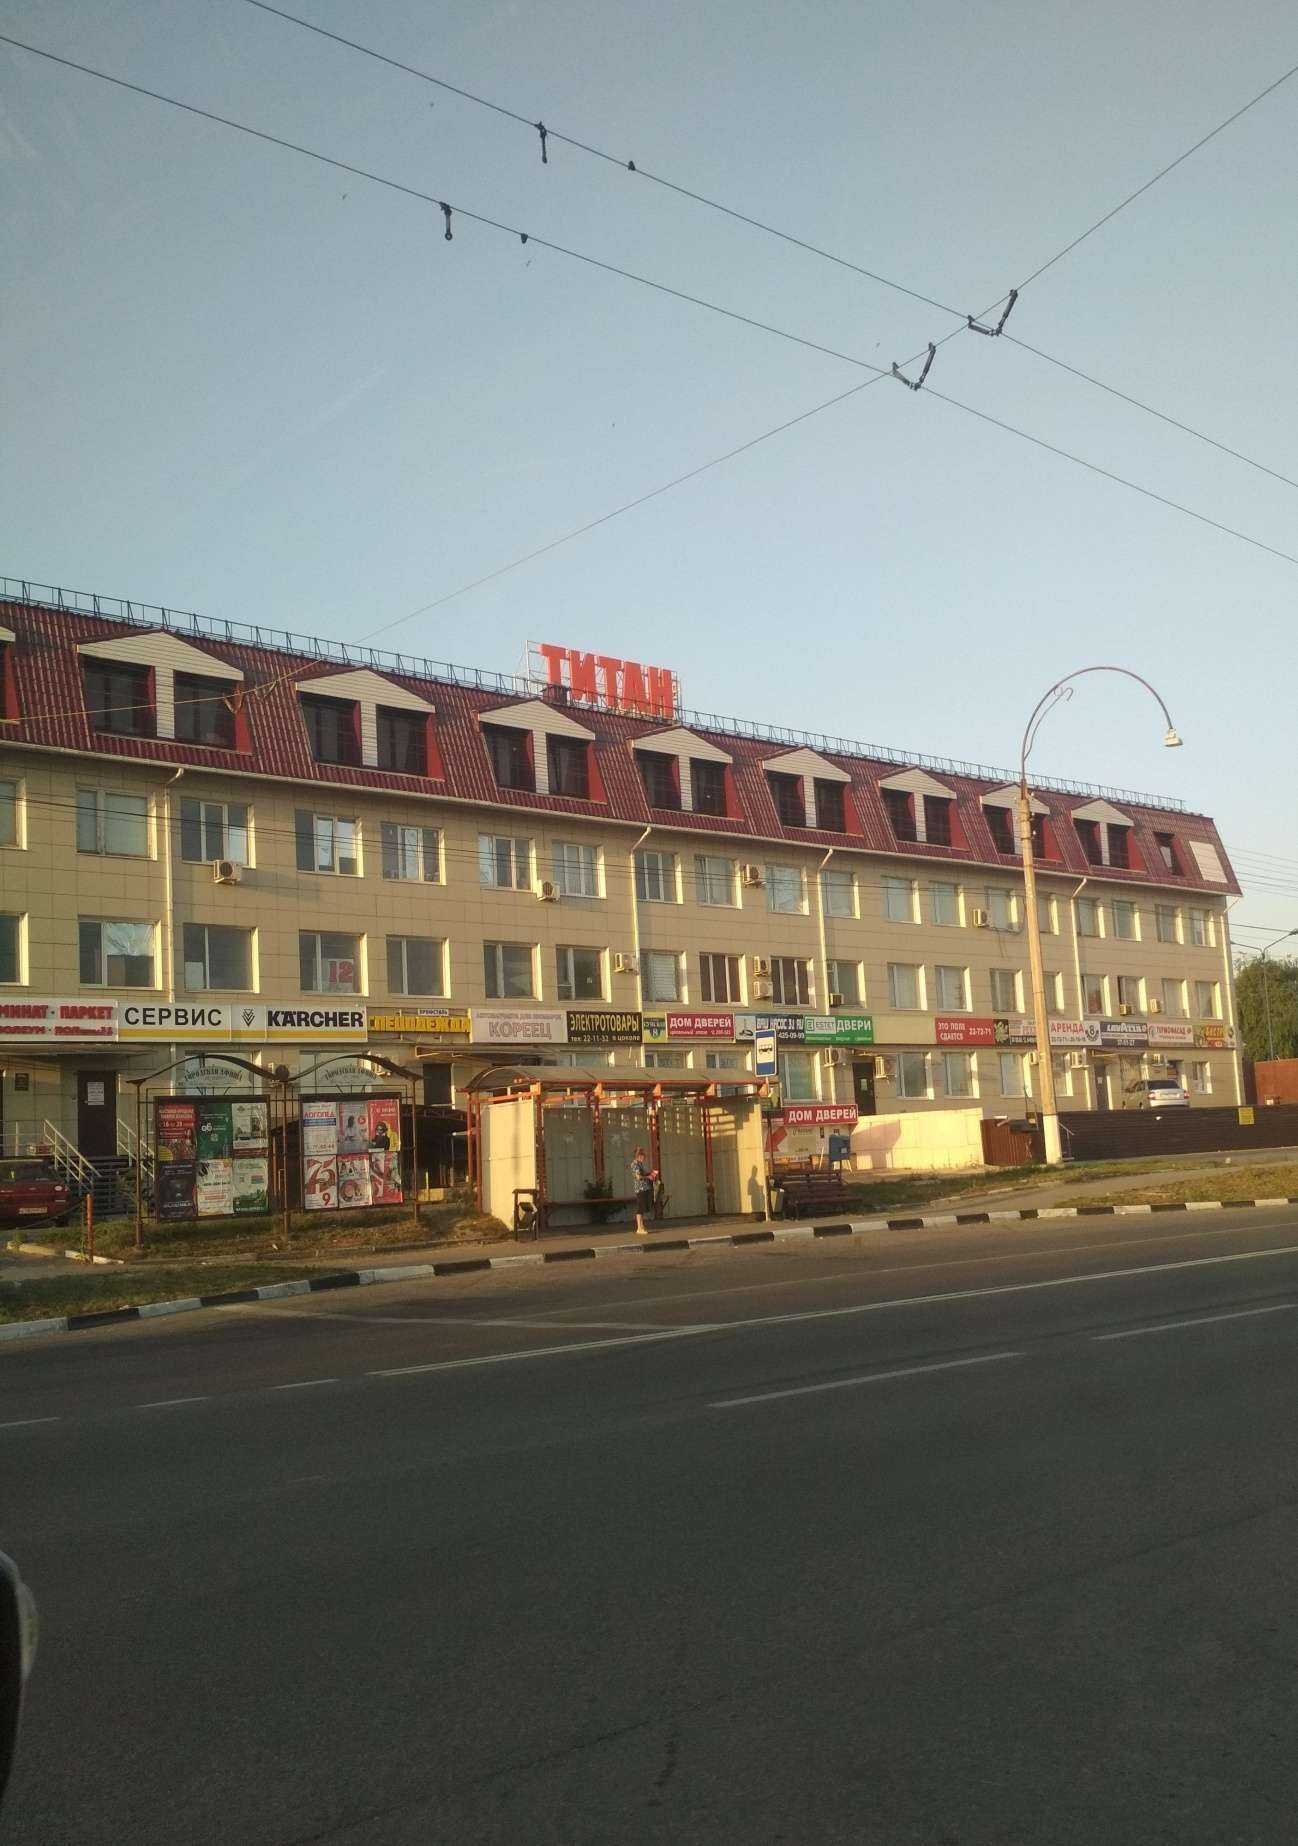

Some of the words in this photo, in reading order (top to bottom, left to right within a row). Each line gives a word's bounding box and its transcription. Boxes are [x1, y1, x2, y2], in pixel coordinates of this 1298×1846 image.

[540, 644, 675, 720] ТИТАН
[328, 960, 354, 984] 12
[60, 1005, 114, 1020] ПАРКЕТ
[124, 1007, 222, 1027] СЕРВИС
[267, 1010, 364, 1028] KÄRCHER
[488, 1020, 553, 1040] КОРЕЕЦ
[570, 1014, 640, 1033] ЭЛЕКТРОТОВАРЫ
[670, 1017, 692, 1029] ДОМ
[694, 1016, 732, 1029] ДВЕРЕЙ
[836, 1019, 872, 1032] ДВЕРИ
[1050, 1023, 1084, 1034] АРЕНДА
[788, 1110, 812, 1123] ДОМ
[815, 1106, 857, 1122] ДВЕРЕЙ
[321, 1192, 331, 1206] 9
